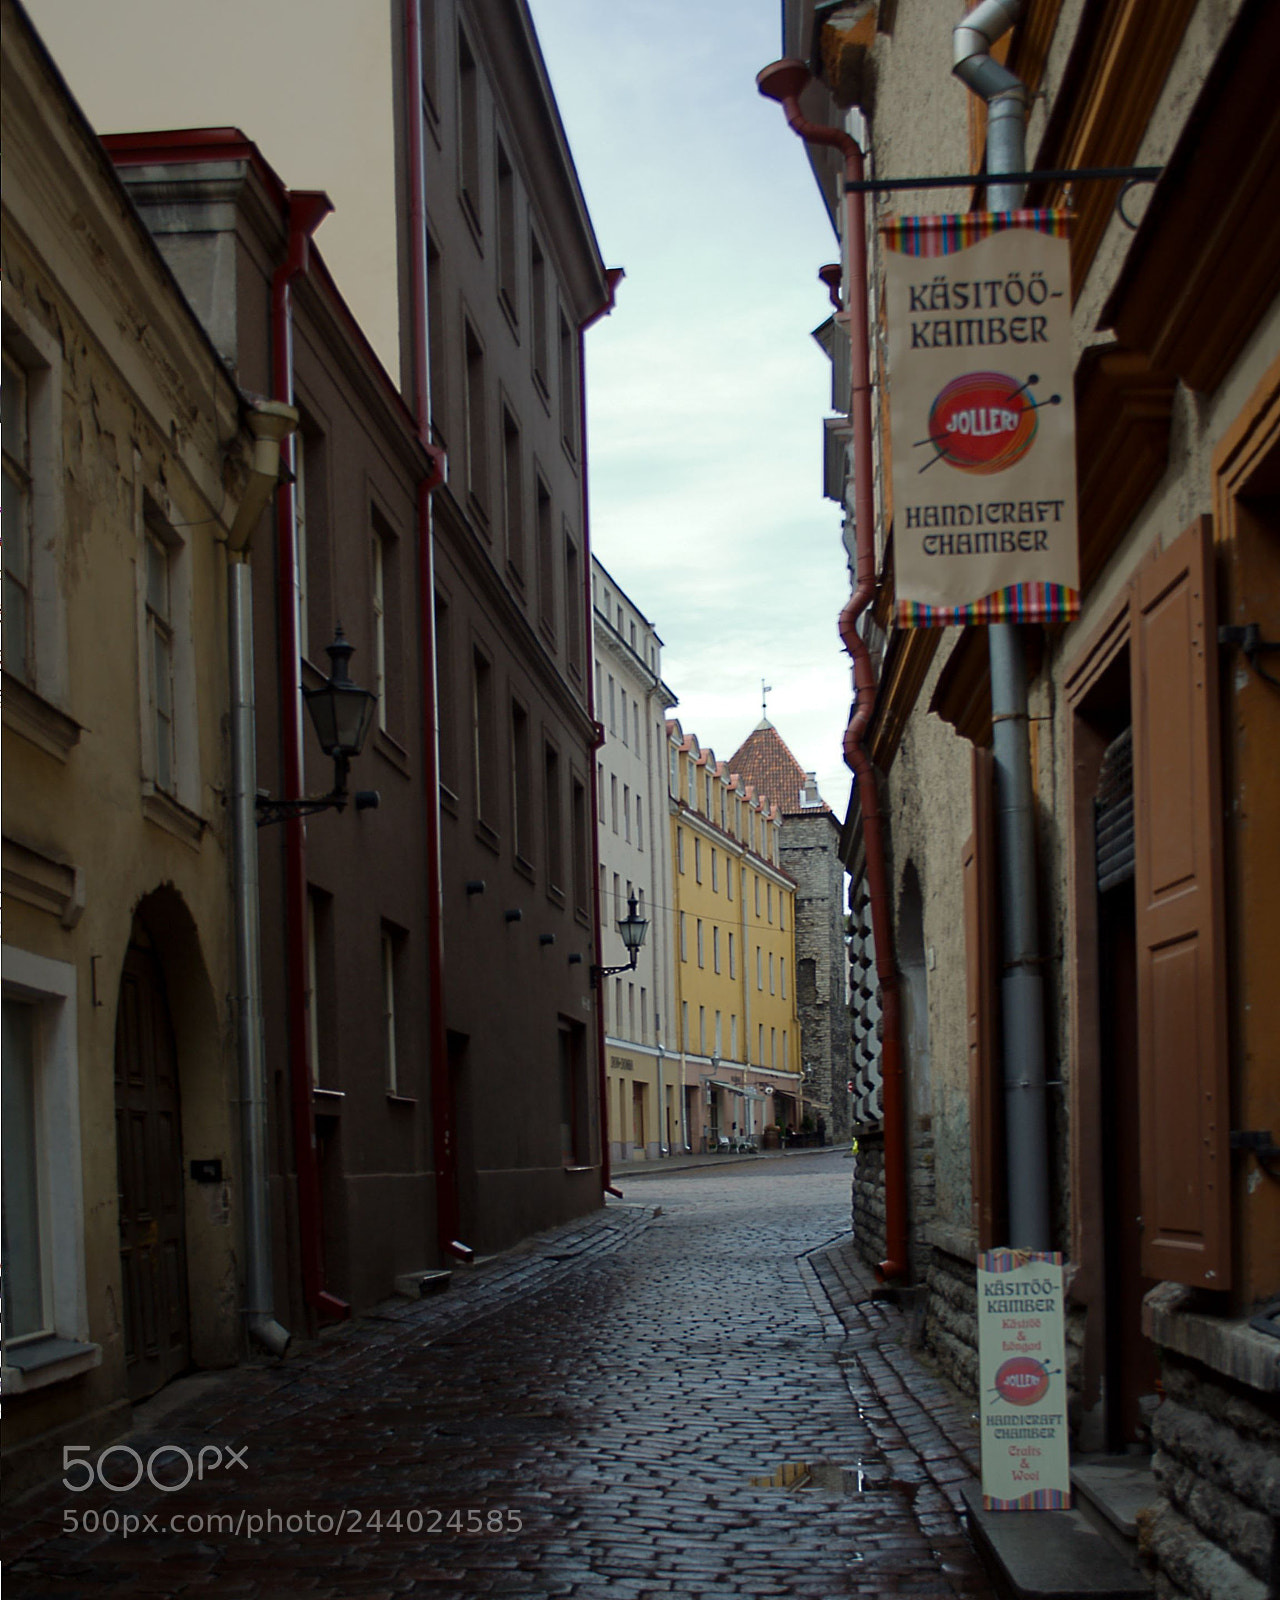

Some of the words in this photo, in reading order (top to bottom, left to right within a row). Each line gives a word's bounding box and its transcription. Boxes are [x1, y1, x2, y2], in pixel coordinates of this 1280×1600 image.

[908, 272, 1064, 313] KÄSITÖÖ-
[910, 316, 1048, 349] KAMBER
[905, 500, 1064, 529] HANDICRAFT
[922, 529, 1049, 556] CHAMBER
[987, 1299, 1055, 1314] KAMBER
[986, 1414, 1063, 1427] HANDICRAFT
[994, 1427, 1055, 1440] CHAMBER
[1011, 1470, 1040, 1481] Wool
